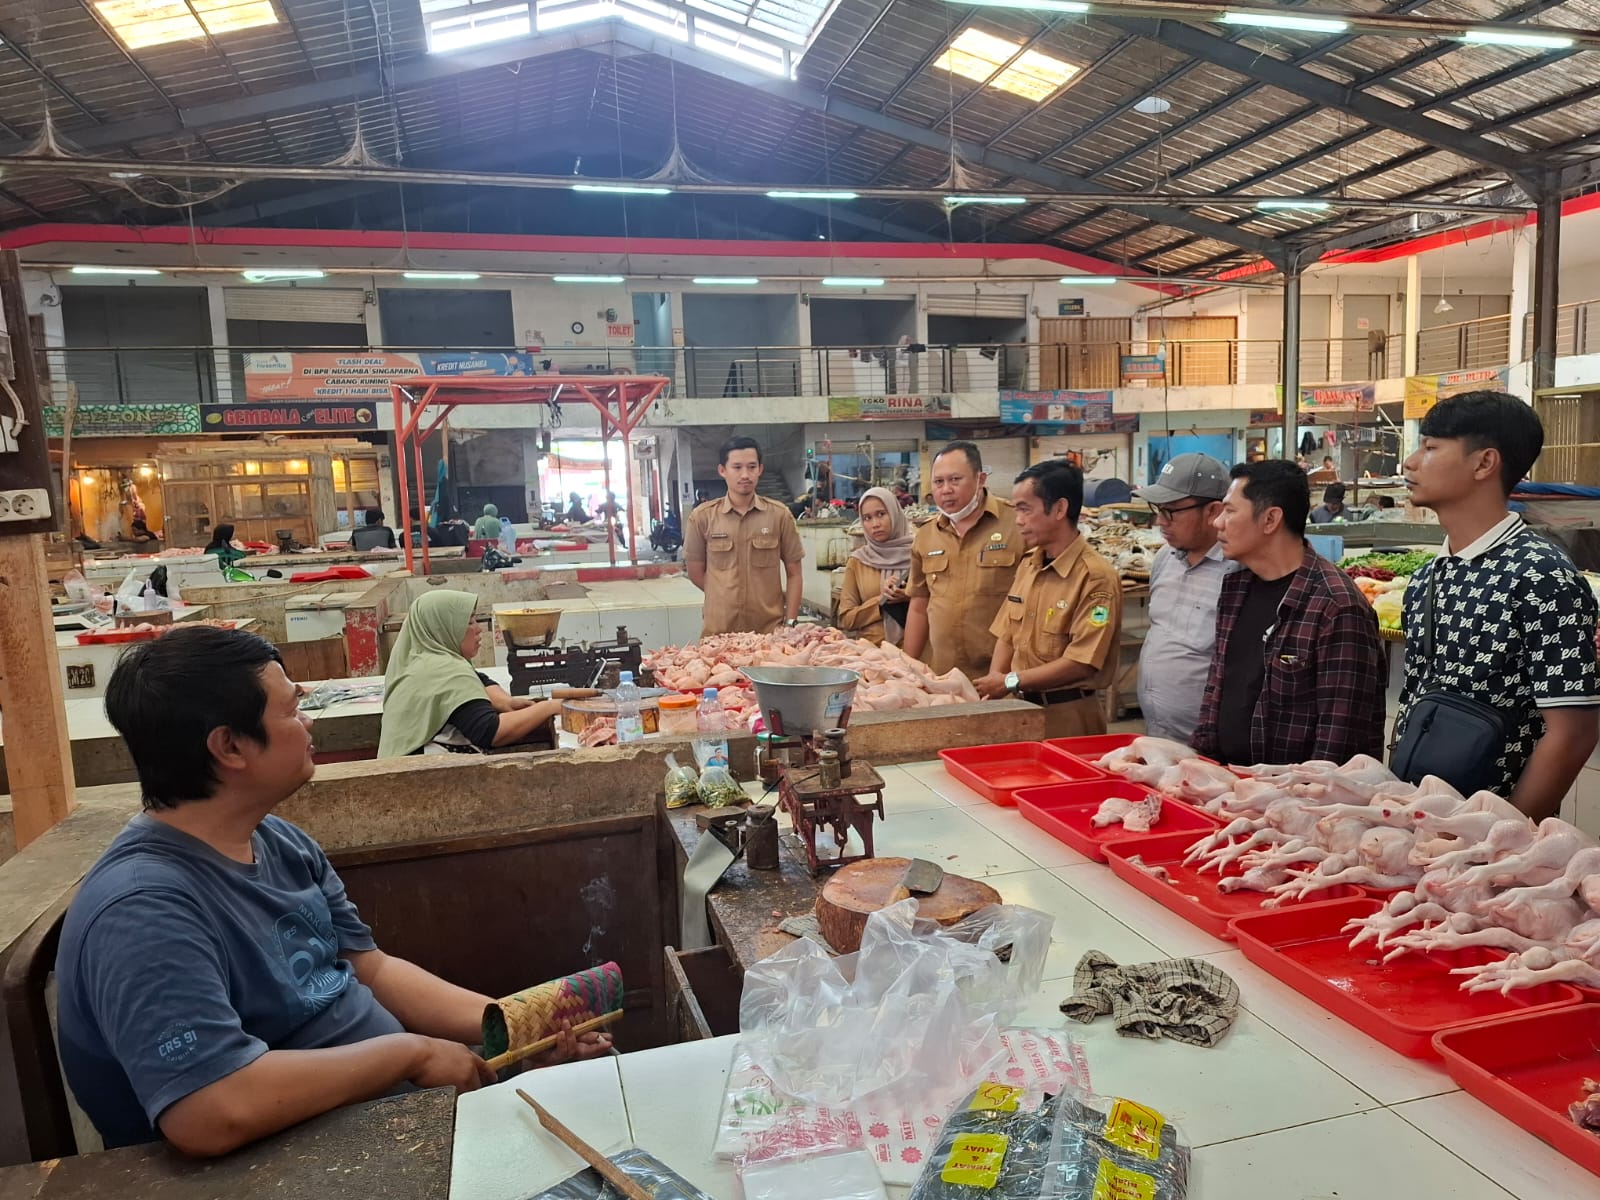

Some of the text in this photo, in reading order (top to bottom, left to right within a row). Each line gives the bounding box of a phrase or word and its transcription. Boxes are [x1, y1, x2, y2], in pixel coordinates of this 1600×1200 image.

[608, 325, 631, 336] TOILET
[436, 359, 488, 371] KREDIT NUSAMBA
[887, 397, 923, 408] RINA
[223, 408, 301, 426] GEMBALA
[315, 407, 356, 425] ELITE
[158, 1036, 182, 1057] CRS
[963, 1144, 994, 1153] KUAT
